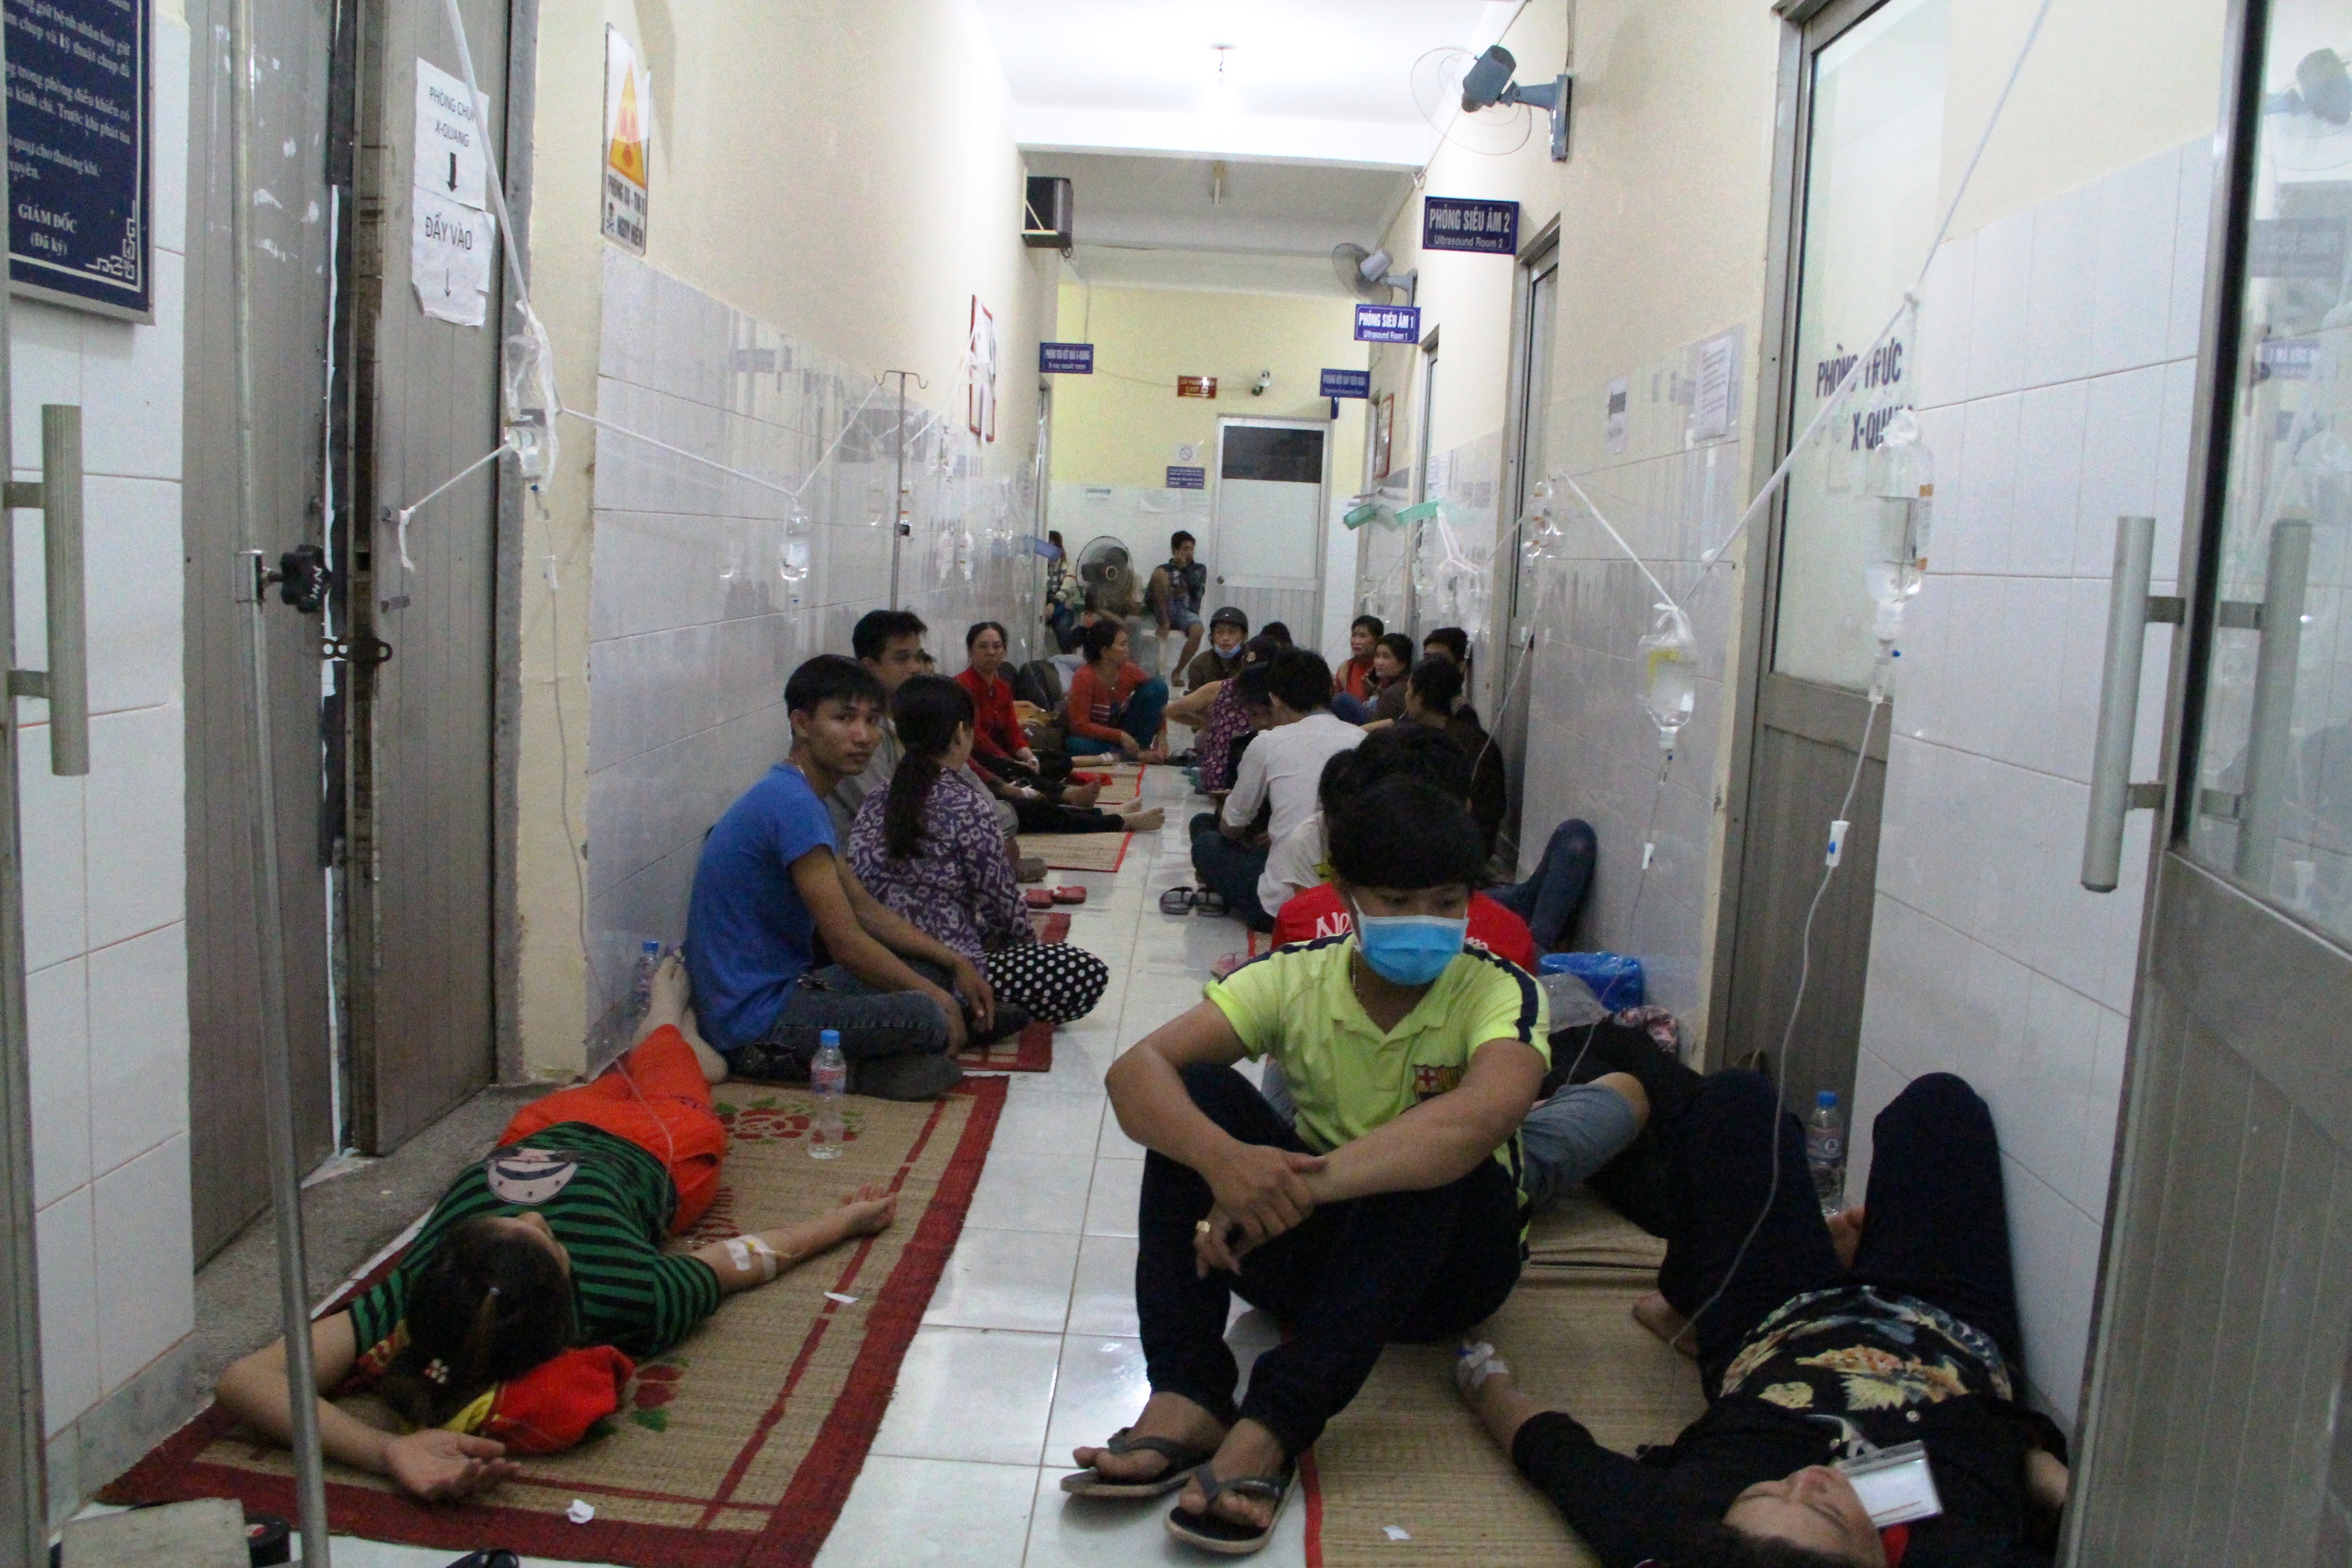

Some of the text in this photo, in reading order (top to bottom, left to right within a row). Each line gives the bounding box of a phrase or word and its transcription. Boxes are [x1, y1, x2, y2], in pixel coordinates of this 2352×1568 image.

[435, 119, 470, 147] X-QUANG
[425, 212, 472, 250] ĐẨY VÀO
[1503, 212, 1510, 233] 2
[1434, 235, 1503, 248] Ultrasound Room 2
[1410, 316, 1414, 329] 1
[1851, 404, 1914, 451] X-QU
